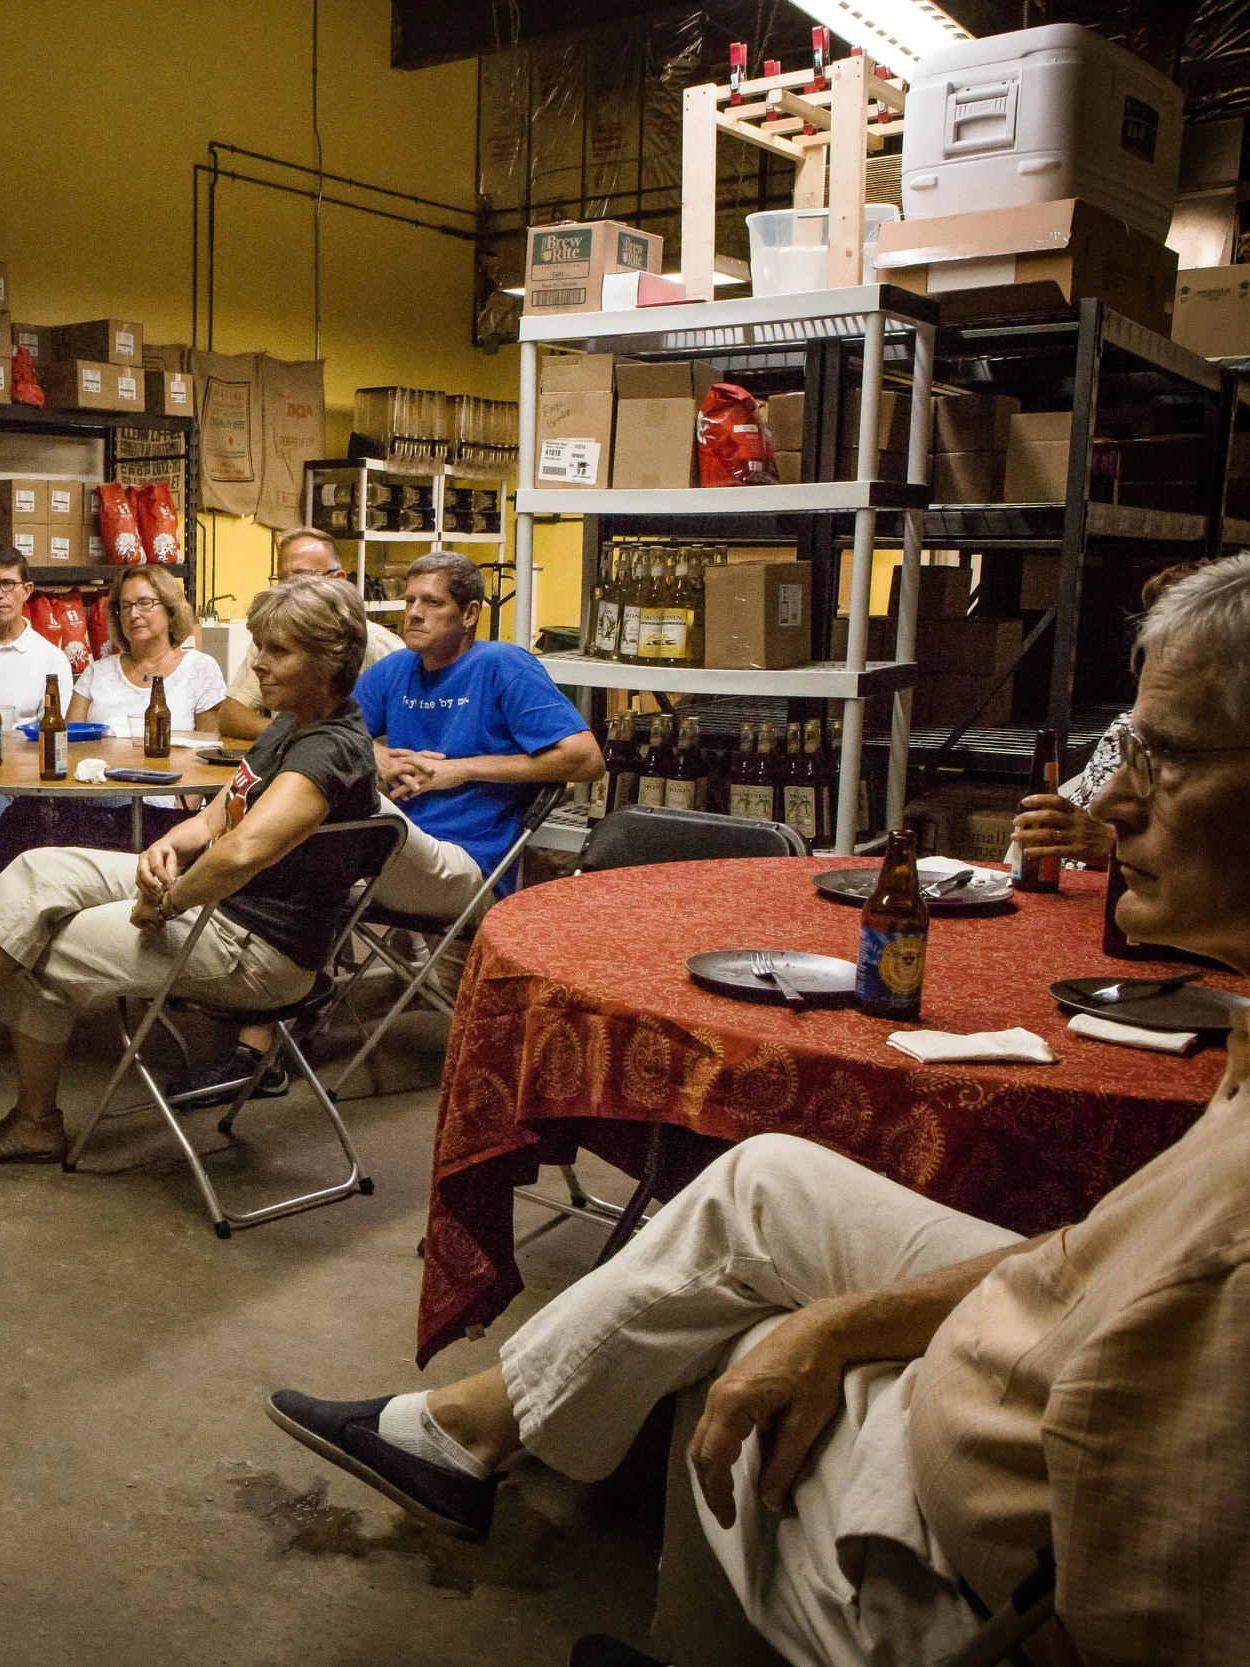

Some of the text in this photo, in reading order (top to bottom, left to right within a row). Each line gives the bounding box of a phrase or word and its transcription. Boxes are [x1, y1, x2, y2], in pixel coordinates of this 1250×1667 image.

[547, 235, 582, 251] Brew
[625, 237, 644, 255] Brew
[552, 246, 581, 262] Rite
[628, 251, 643, 266] Rite
[438, 698, 454, 709] by
[960, 830, 1007, 845] Small
